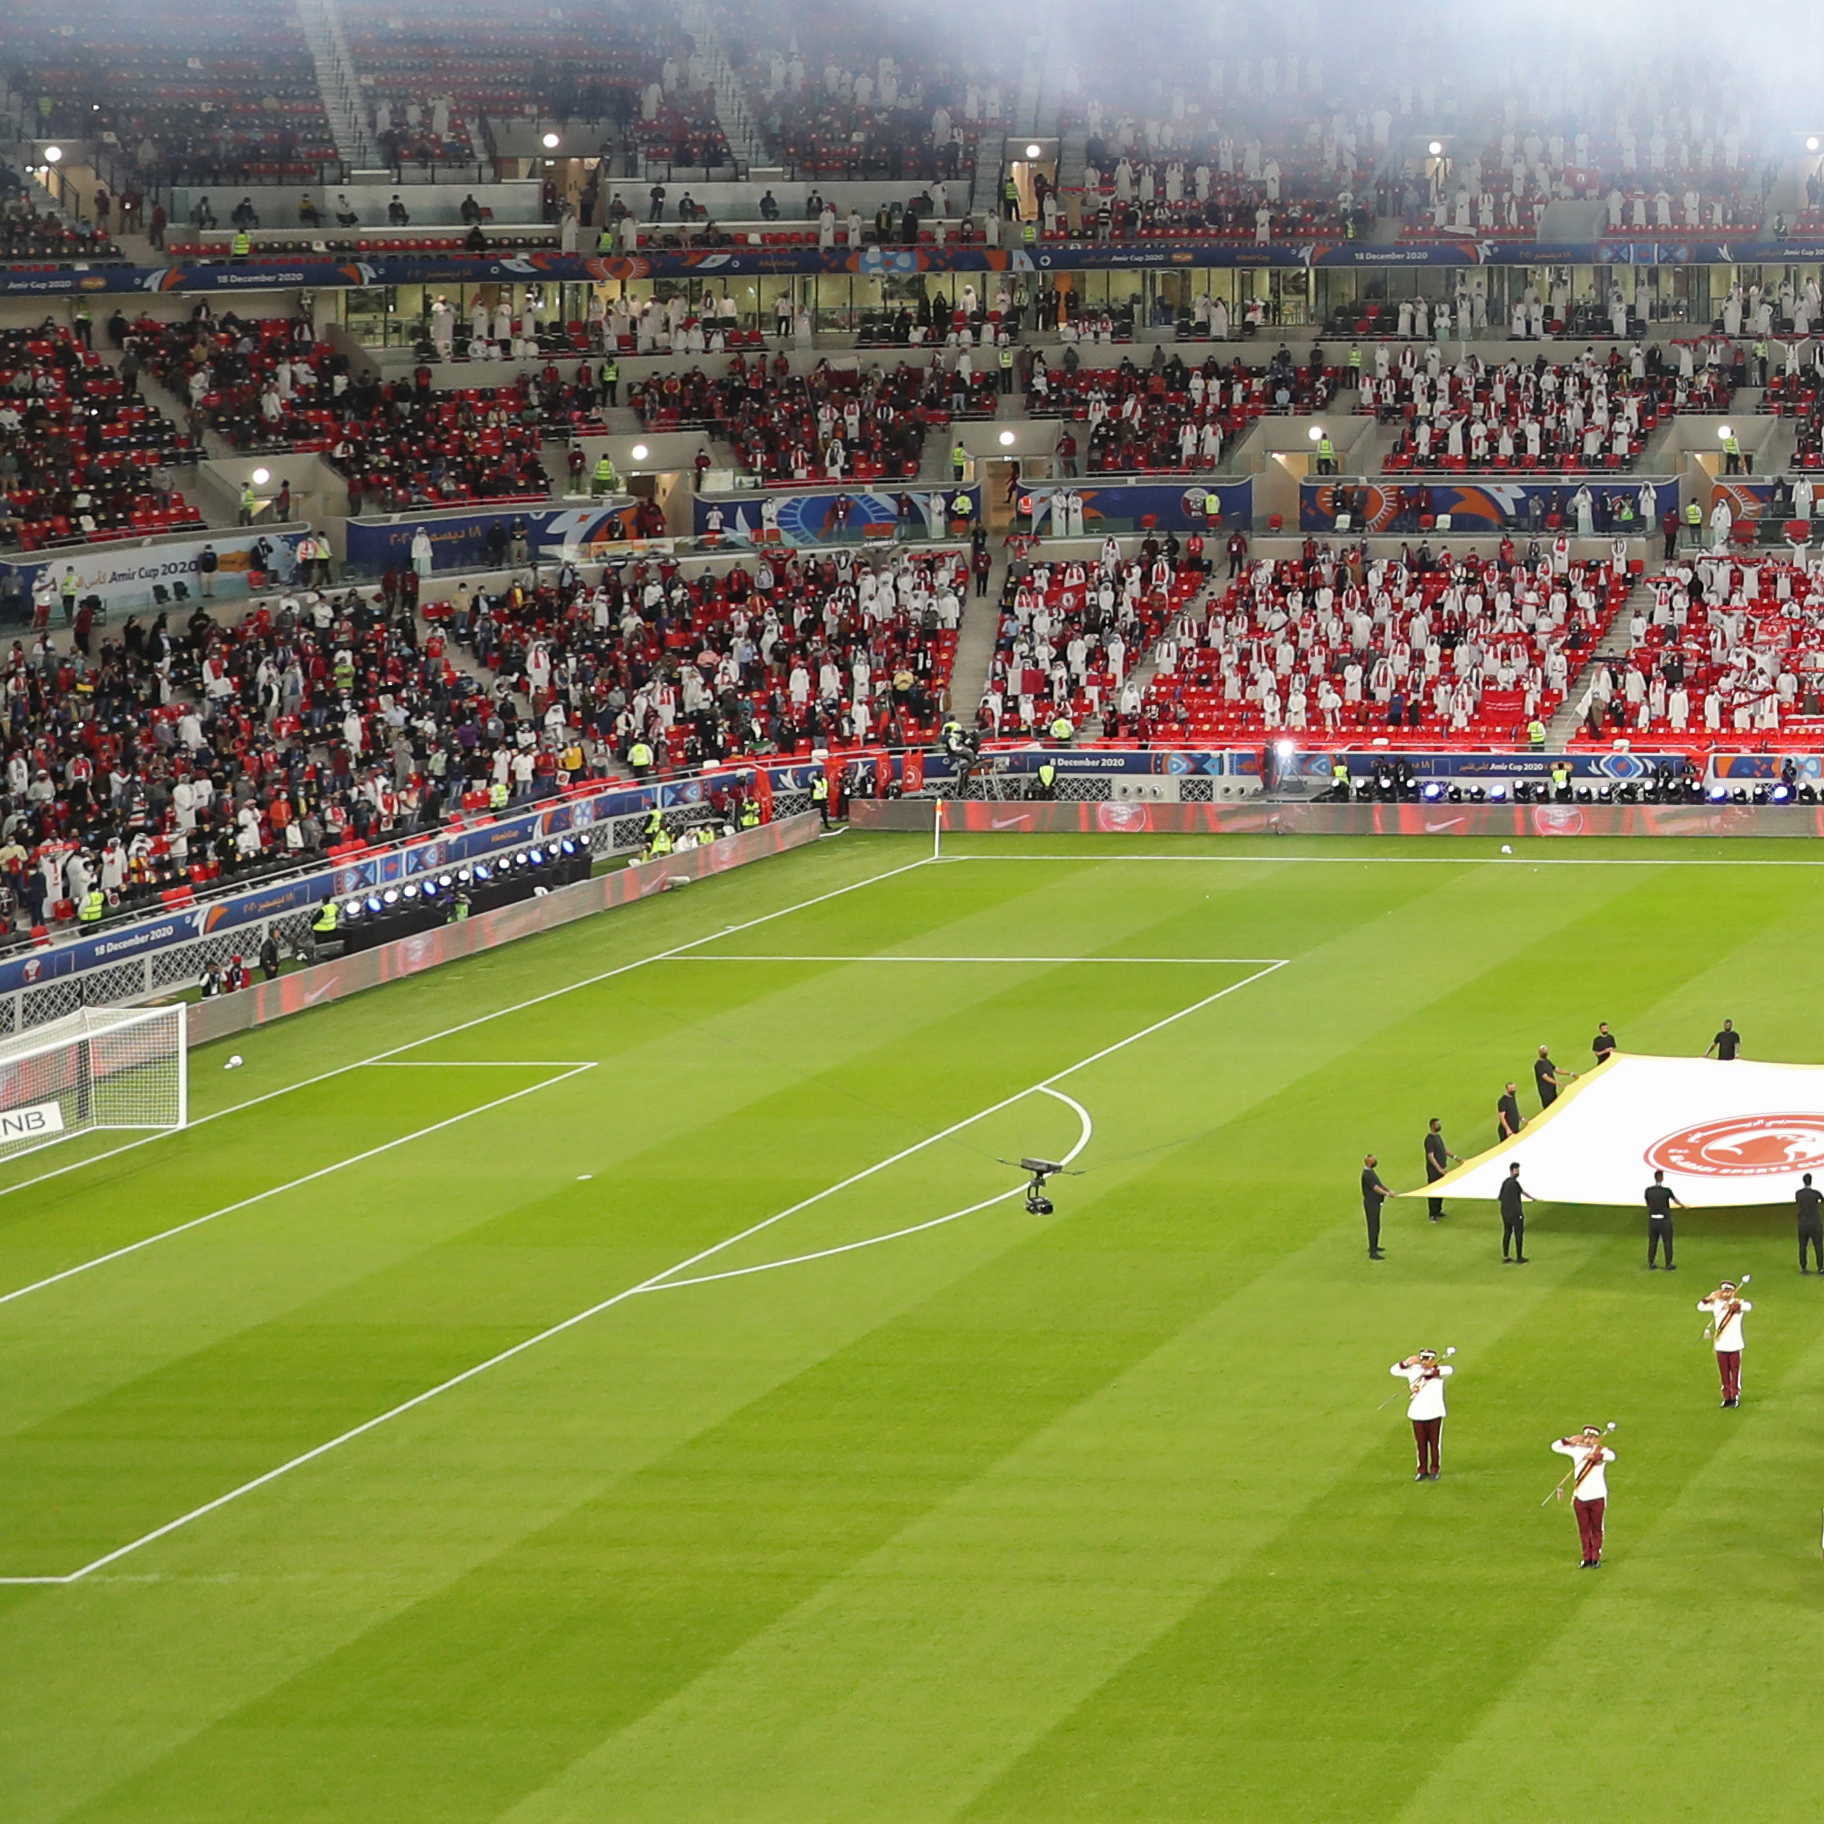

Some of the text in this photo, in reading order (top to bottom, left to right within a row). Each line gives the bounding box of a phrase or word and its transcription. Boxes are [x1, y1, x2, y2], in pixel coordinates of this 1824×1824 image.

[1110, 252, 1128, 262] Amir
[1128, 252, 1144, 262] Cup
[1144, 252, 1164, 262] 2020
[1355, 252, 1428, 260] 18 December 2020
[1783, 248, 1799, 257] Amir
[1800, 248, 1815, 257] Cup
[217, 273, 304, 284] 18 December 2020
[7, 280, 27, 290] Amir
[28, 280, 47, 290] Cup
[47, 280, 72, 290] 2020
[109, 560, 198, 583] Amir Cup 2020
[1057, 758, 1099, 767] December
[1101, 758, 1125, 766] 2020
[1489, 762, 1544, 772] Amir Cup 2020
[94, 925, 174, 956] 18 December 2020
[0, 1111, 46, 1136] NB
[1719, 1165, 1791, 1175] SPORTS
